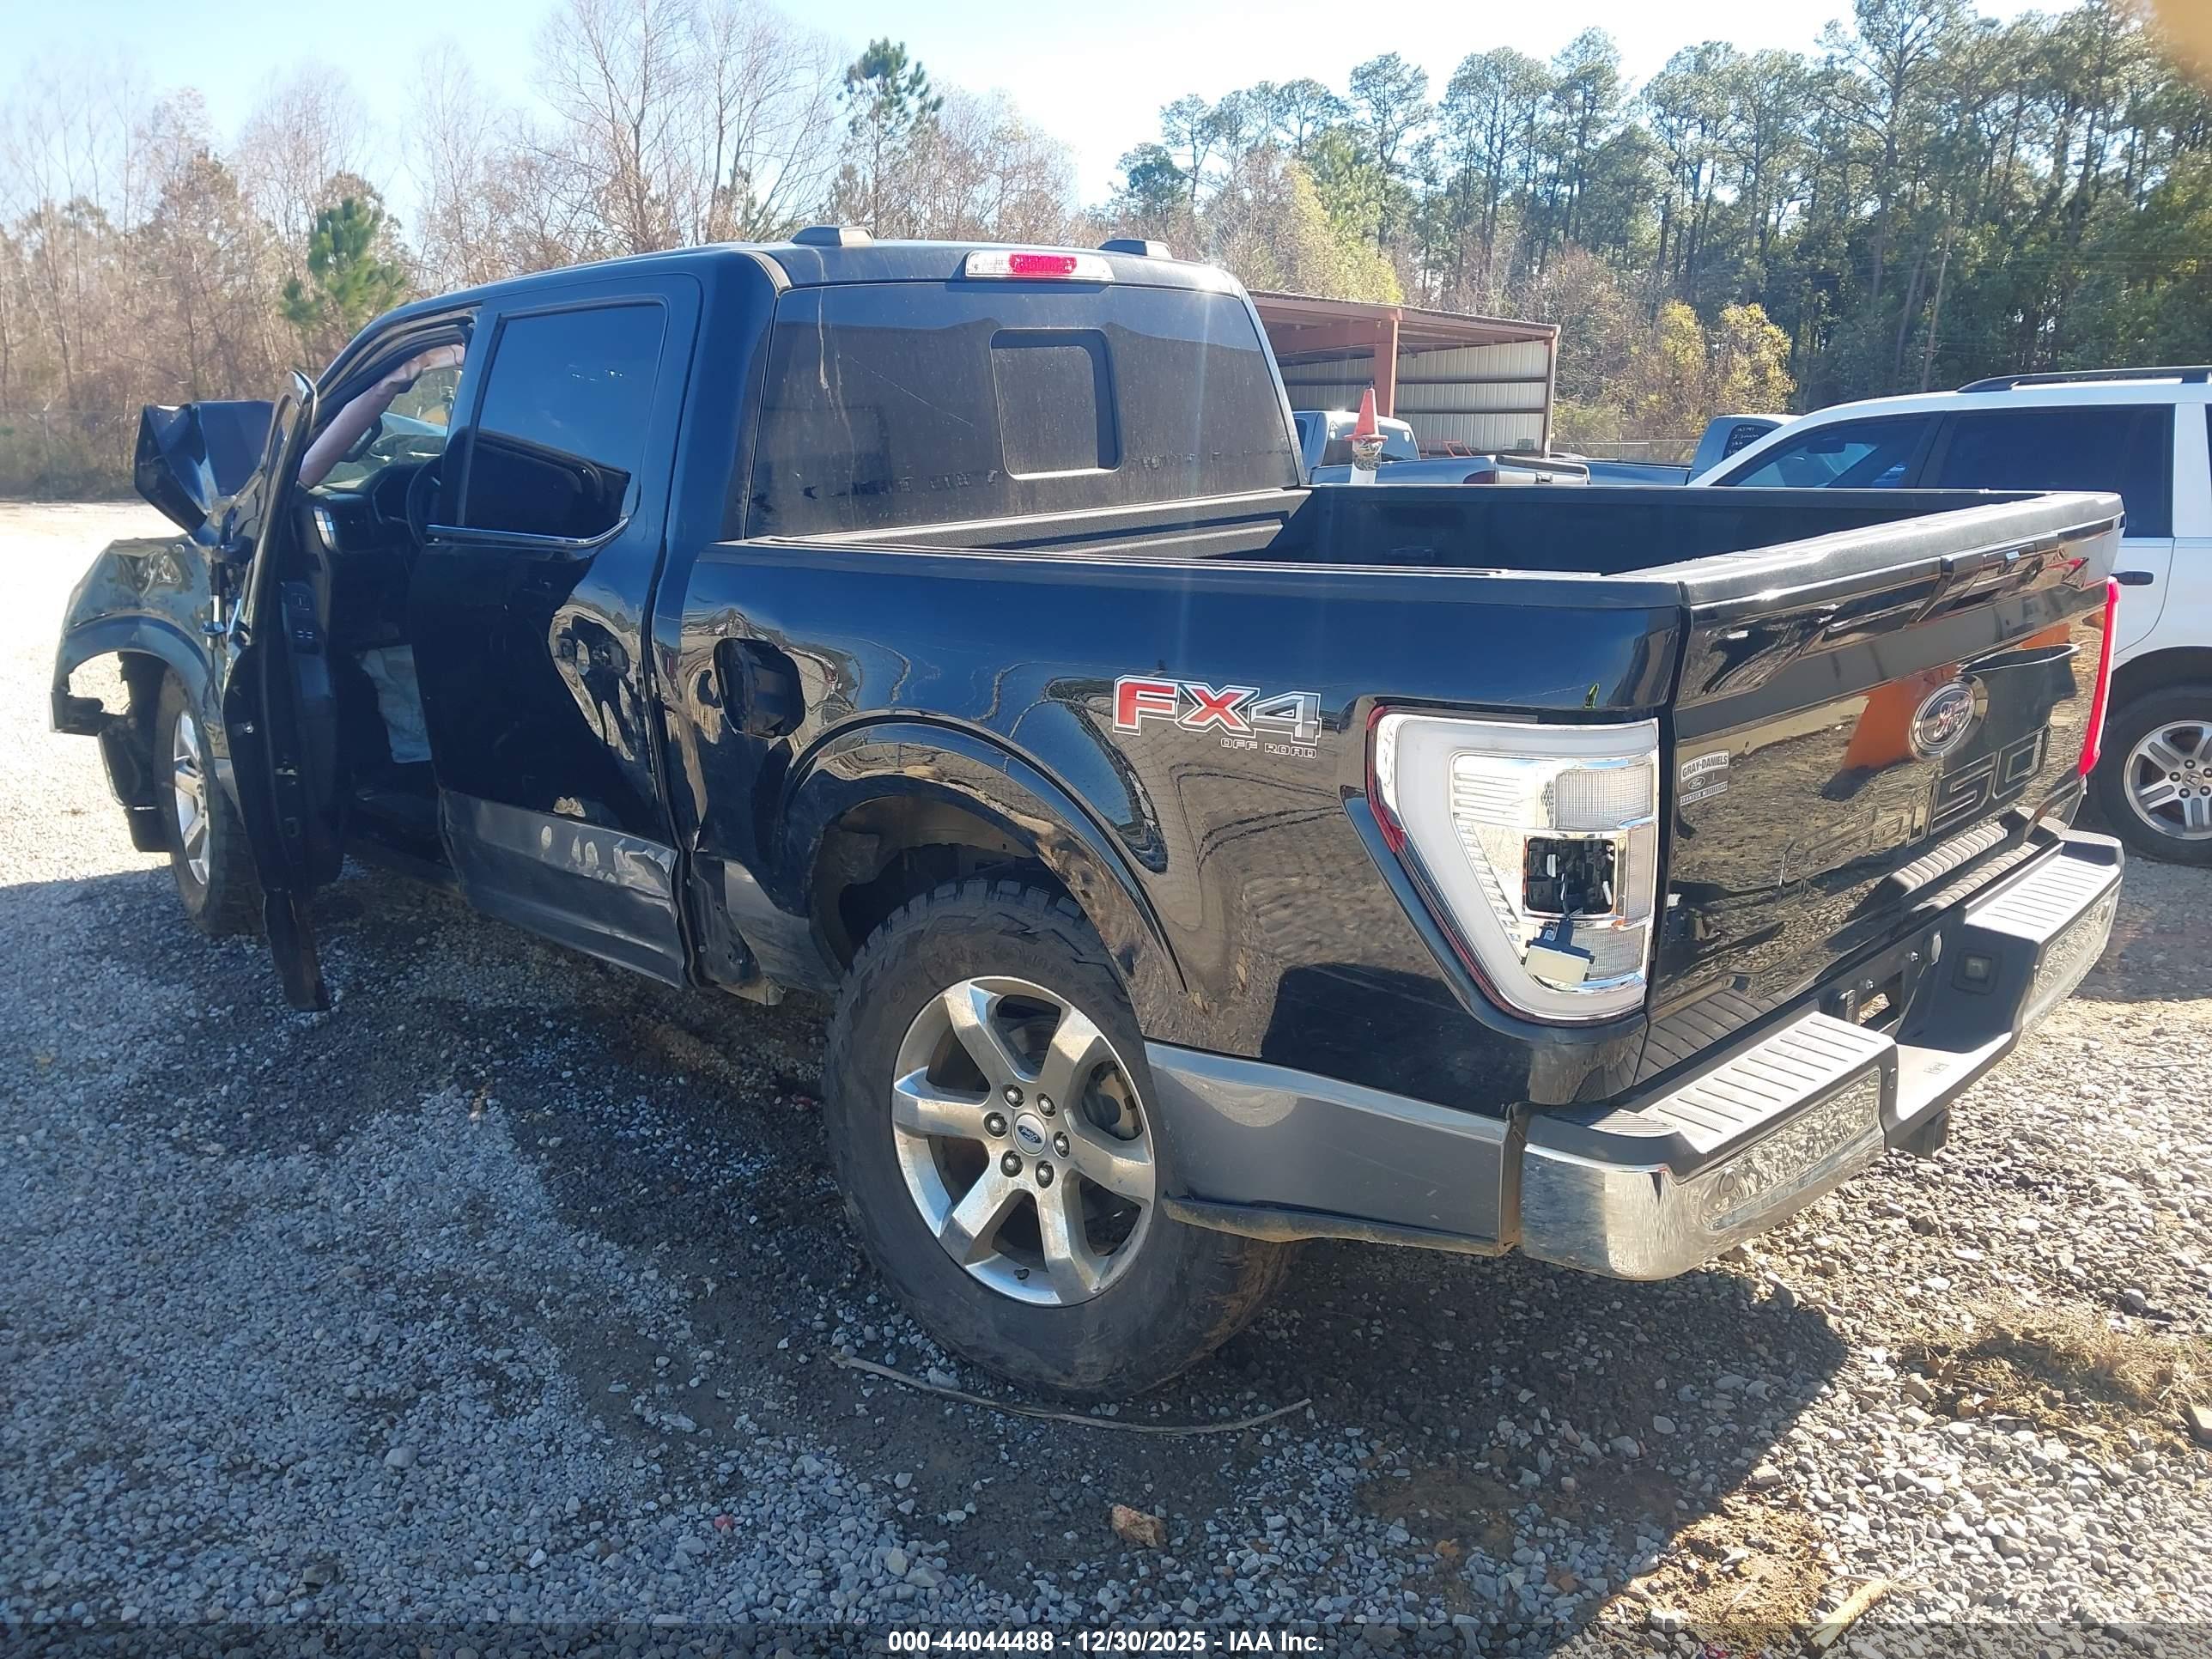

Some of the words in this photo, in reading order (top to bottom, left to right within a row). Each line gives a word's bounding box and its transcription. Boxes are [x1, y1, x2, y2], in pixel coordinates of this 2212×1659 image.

[1112, 675, 1322, 746] FX4
[1220, 738, 1259, 751] OFF
[1264, 743, 1317, 759] ROAD
